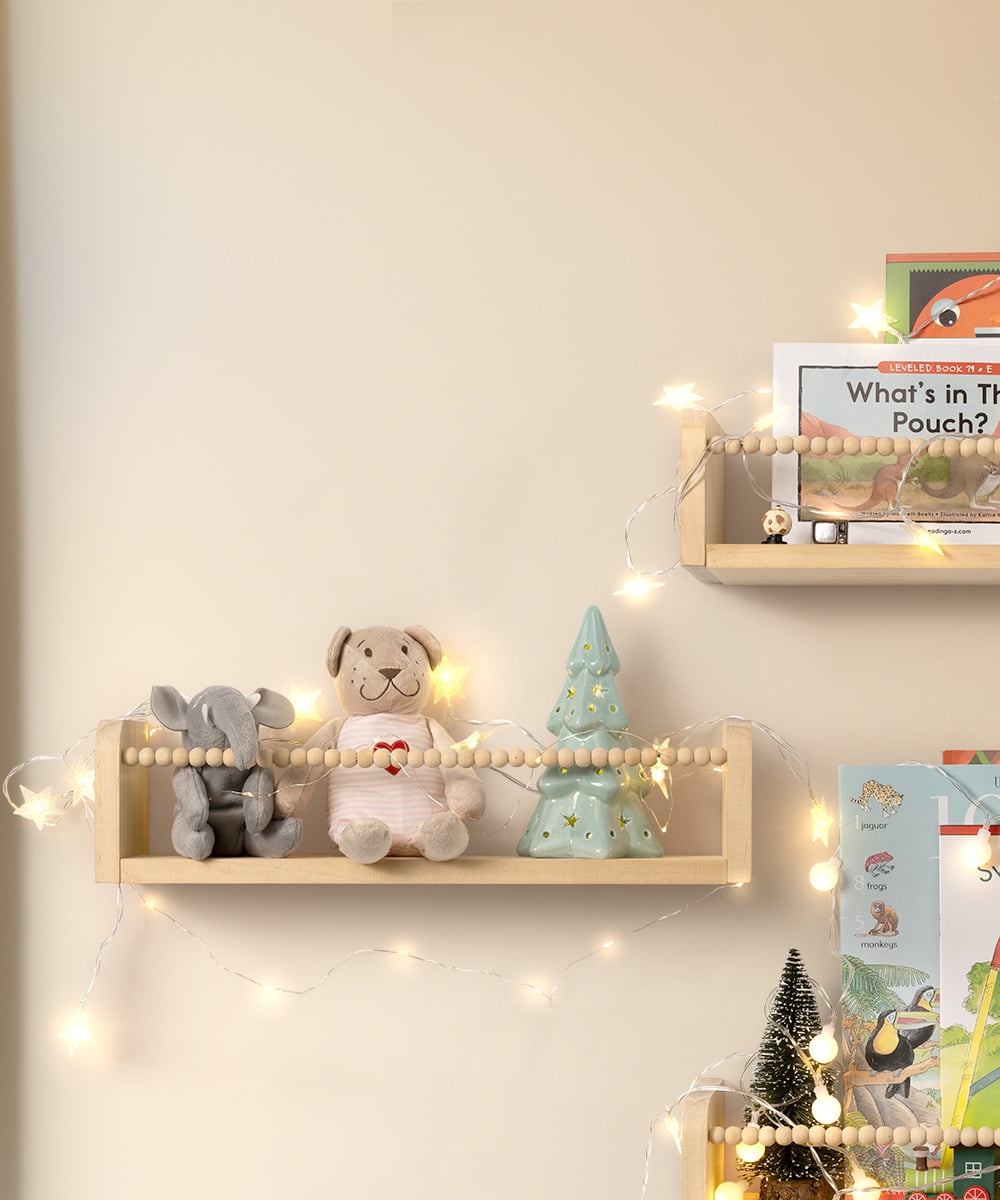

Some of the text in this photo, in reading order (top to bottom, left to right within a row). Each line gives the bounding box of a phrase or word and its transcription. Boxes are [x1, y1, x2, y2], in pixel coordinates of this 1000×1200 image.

[889, 363, 932, 372] LEVELED
[936, 364, 963, 373] BOOK
[986, 365, 992, 373] E
[846, 381, 936, 404] What's
[946, 384, 968, 404] in
[893, 411, 989, 434] Pouch?
[861, 821, 888, 831] jaguar
[854, 874, 888, 891] 8 frogs
[856, 915, 898, 950] 5 monkeys
